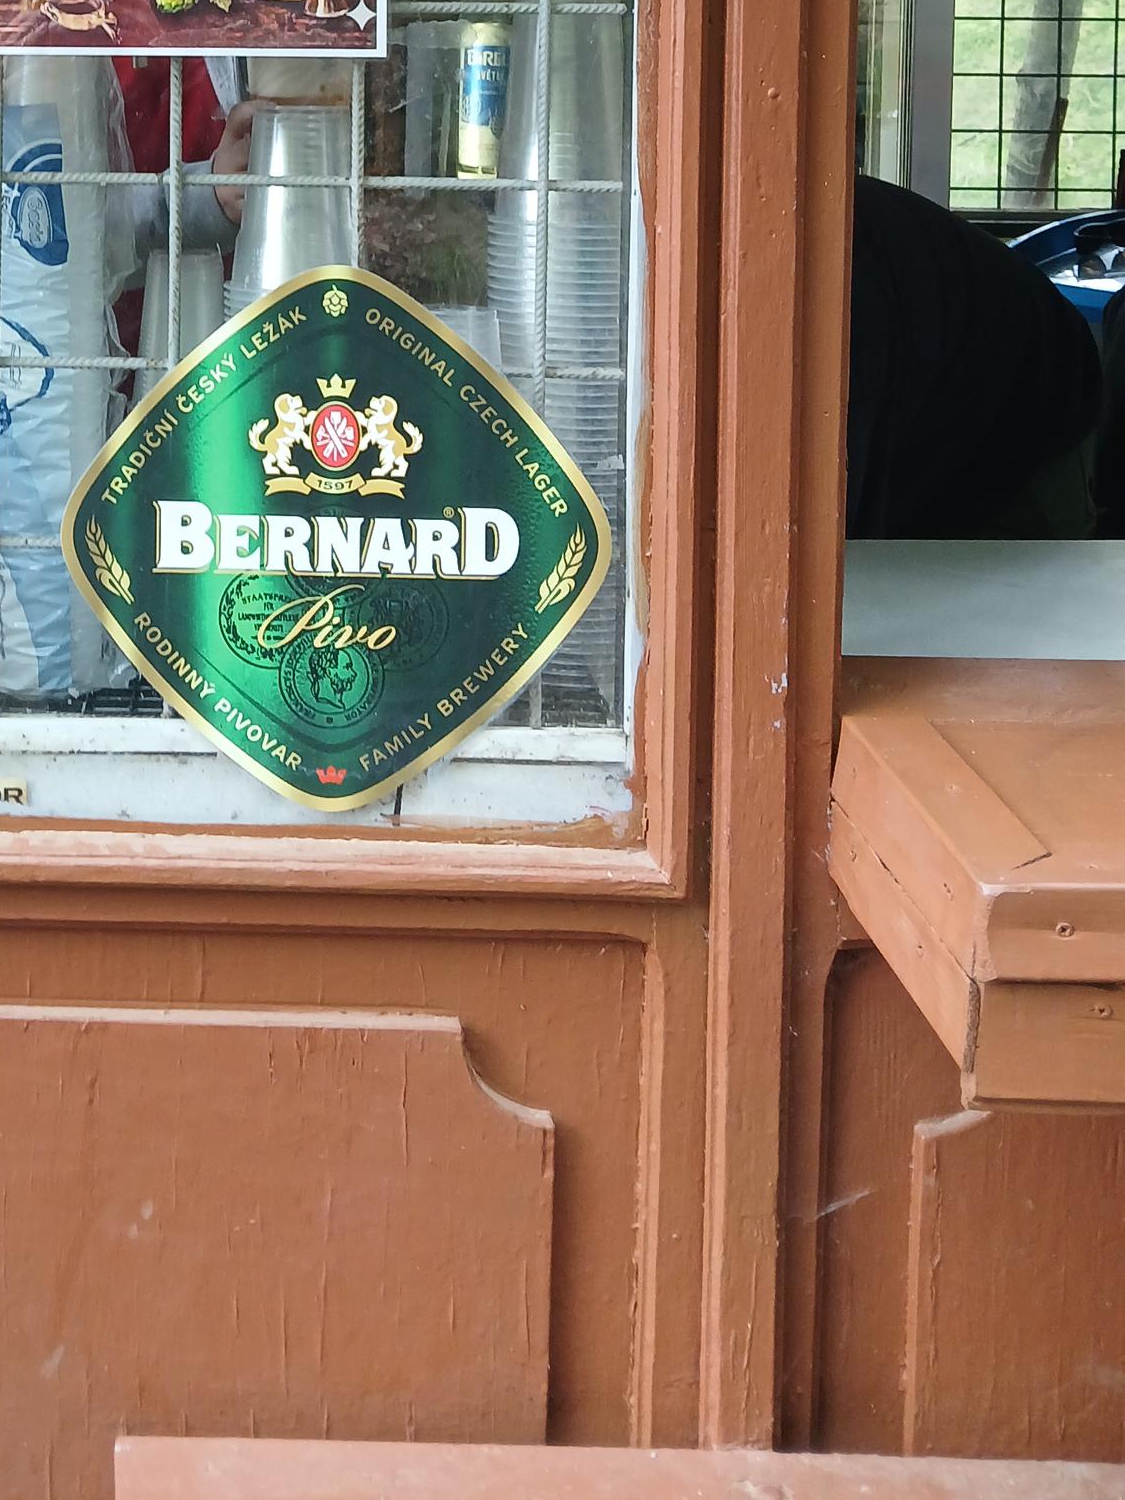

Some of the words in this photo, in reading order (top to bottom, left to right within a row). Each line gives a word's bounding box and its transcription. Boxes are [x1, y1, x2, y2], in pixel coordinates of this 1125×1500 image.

[102, 412, 180, 505] TRADIČNÍ
[174, 353, 239, 414] ČESKÝ
[243, 307, 309, 361] LEŽÁK
[364, 307, 455, 388] ORIGINAL
[458, 385, 518, 449] CZECH
[514, 446, 568, 520] LAGER
[153, 499, 520, 579] BERNARD
[317, 477, 355, 491] 1597
[132, 610, 216, 699] RODINNÝ
[214, 695, 303, 771] PIVOVAR
[257, 584, 396, 651] Pivo
[358, 714, 433, 772] FAMILY
[435, 621, 530, 719] BREWERY
